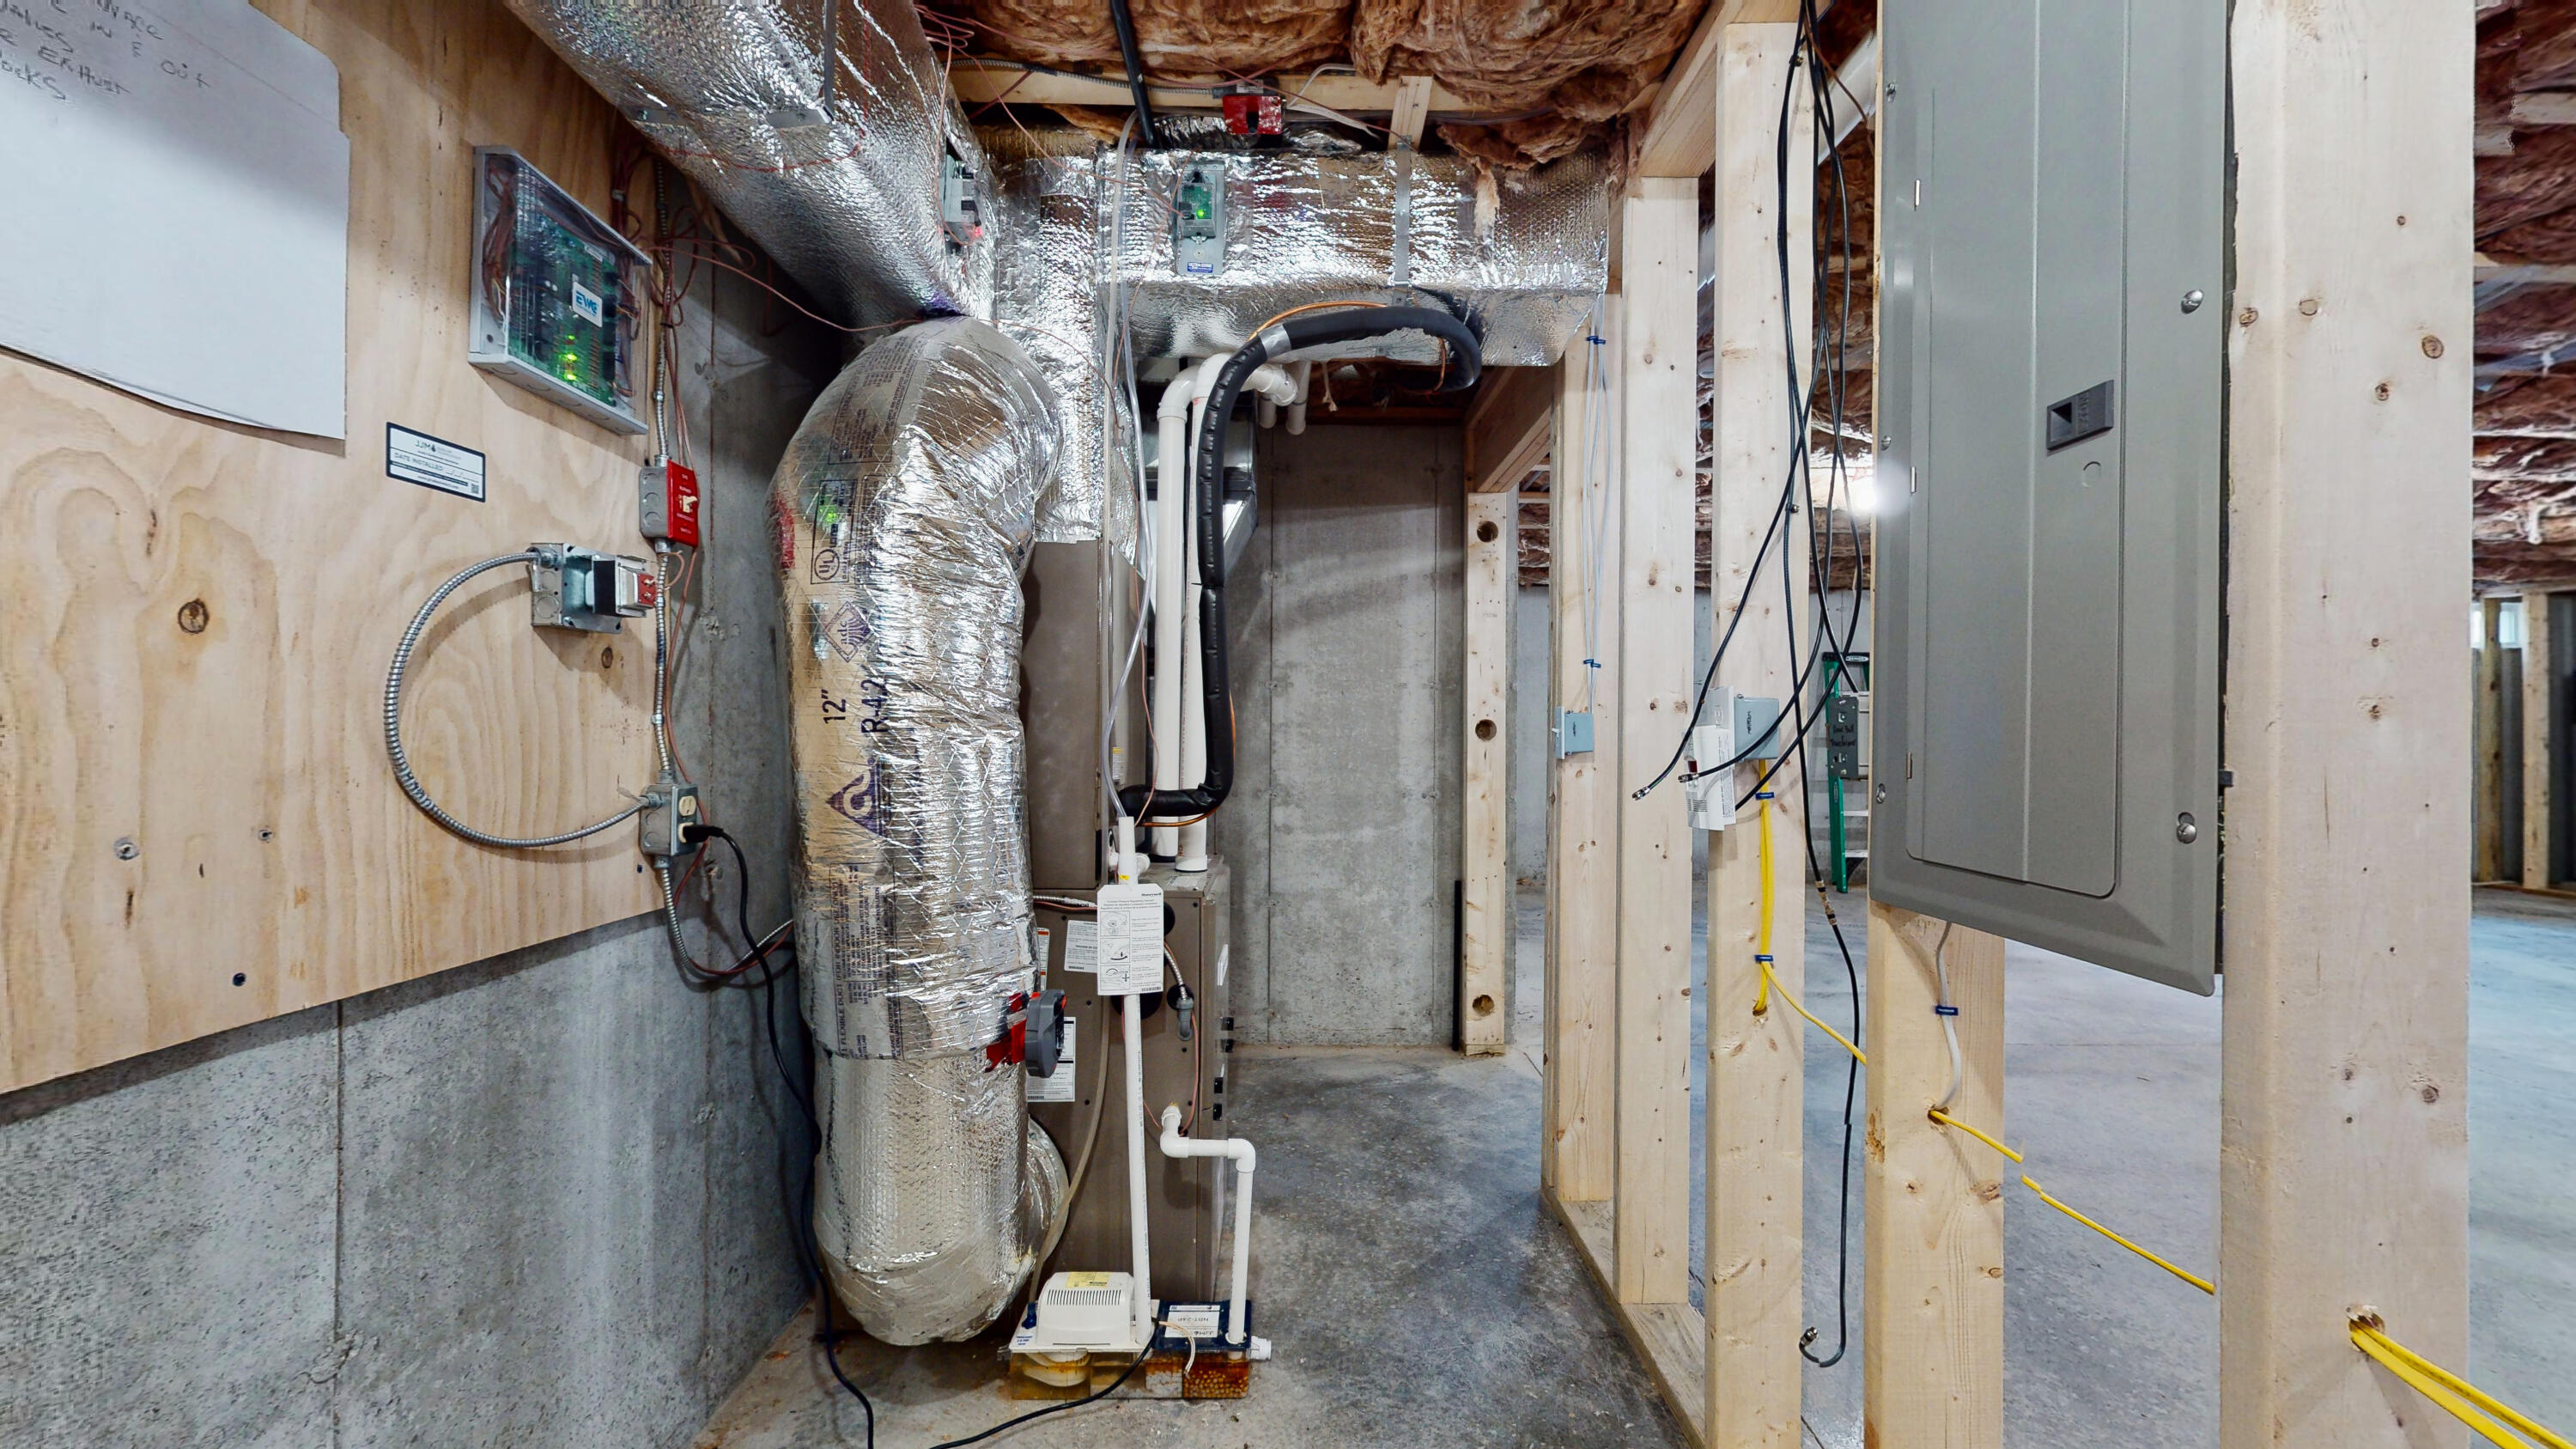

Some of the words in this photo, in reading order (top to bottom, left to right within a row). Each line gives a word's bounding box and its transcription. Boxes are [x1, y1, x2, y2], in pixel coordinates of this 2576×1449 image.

[818, 554, 835, 574] UL
[836, 984, 845, 1006] DUCT
[838, 1008, 847, 1045] FLEXIBLE
